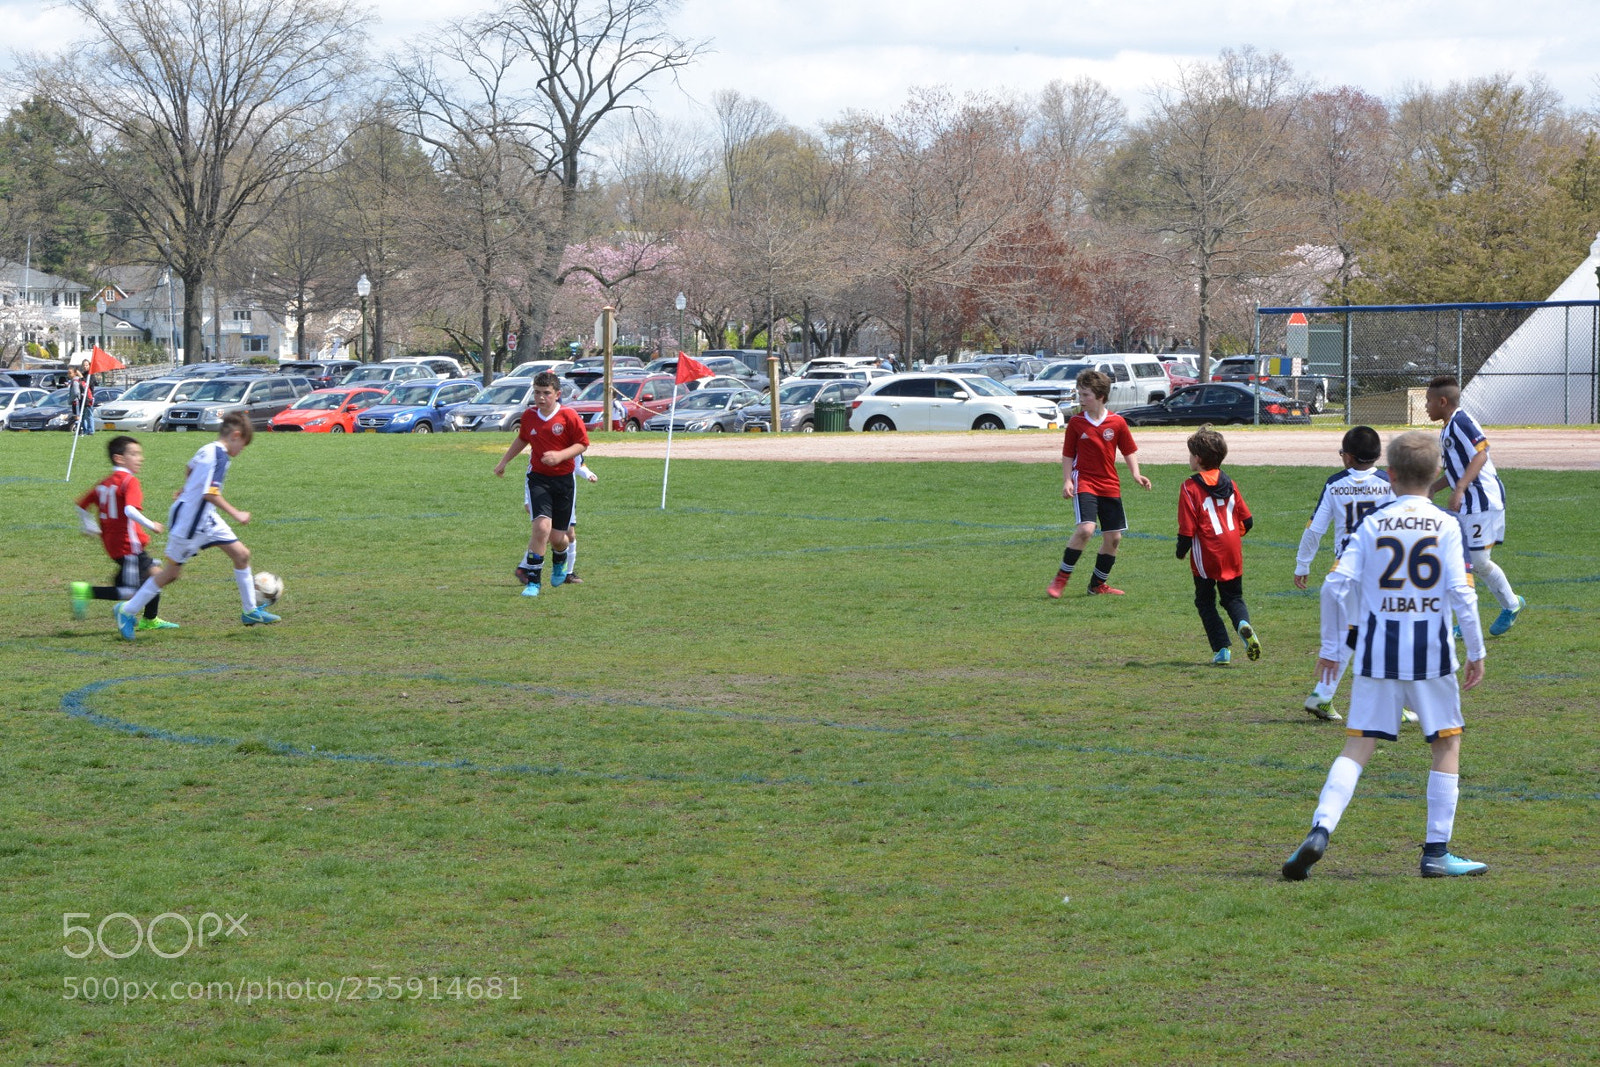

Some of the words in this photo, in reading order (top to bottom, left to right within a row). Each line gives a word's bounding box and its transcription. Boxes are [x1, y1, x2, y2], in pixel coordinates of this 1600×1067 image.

[1202, 494, 1235, 535] 17
[1378, 517, 1442, 532] TKACHEV
[1472, 524, 1482, 539] 2
[1376, 536, 1441, 590] 26
[1380, 597, 1416, 612] ALBA
[1422, 597, 1440, 612] FC
